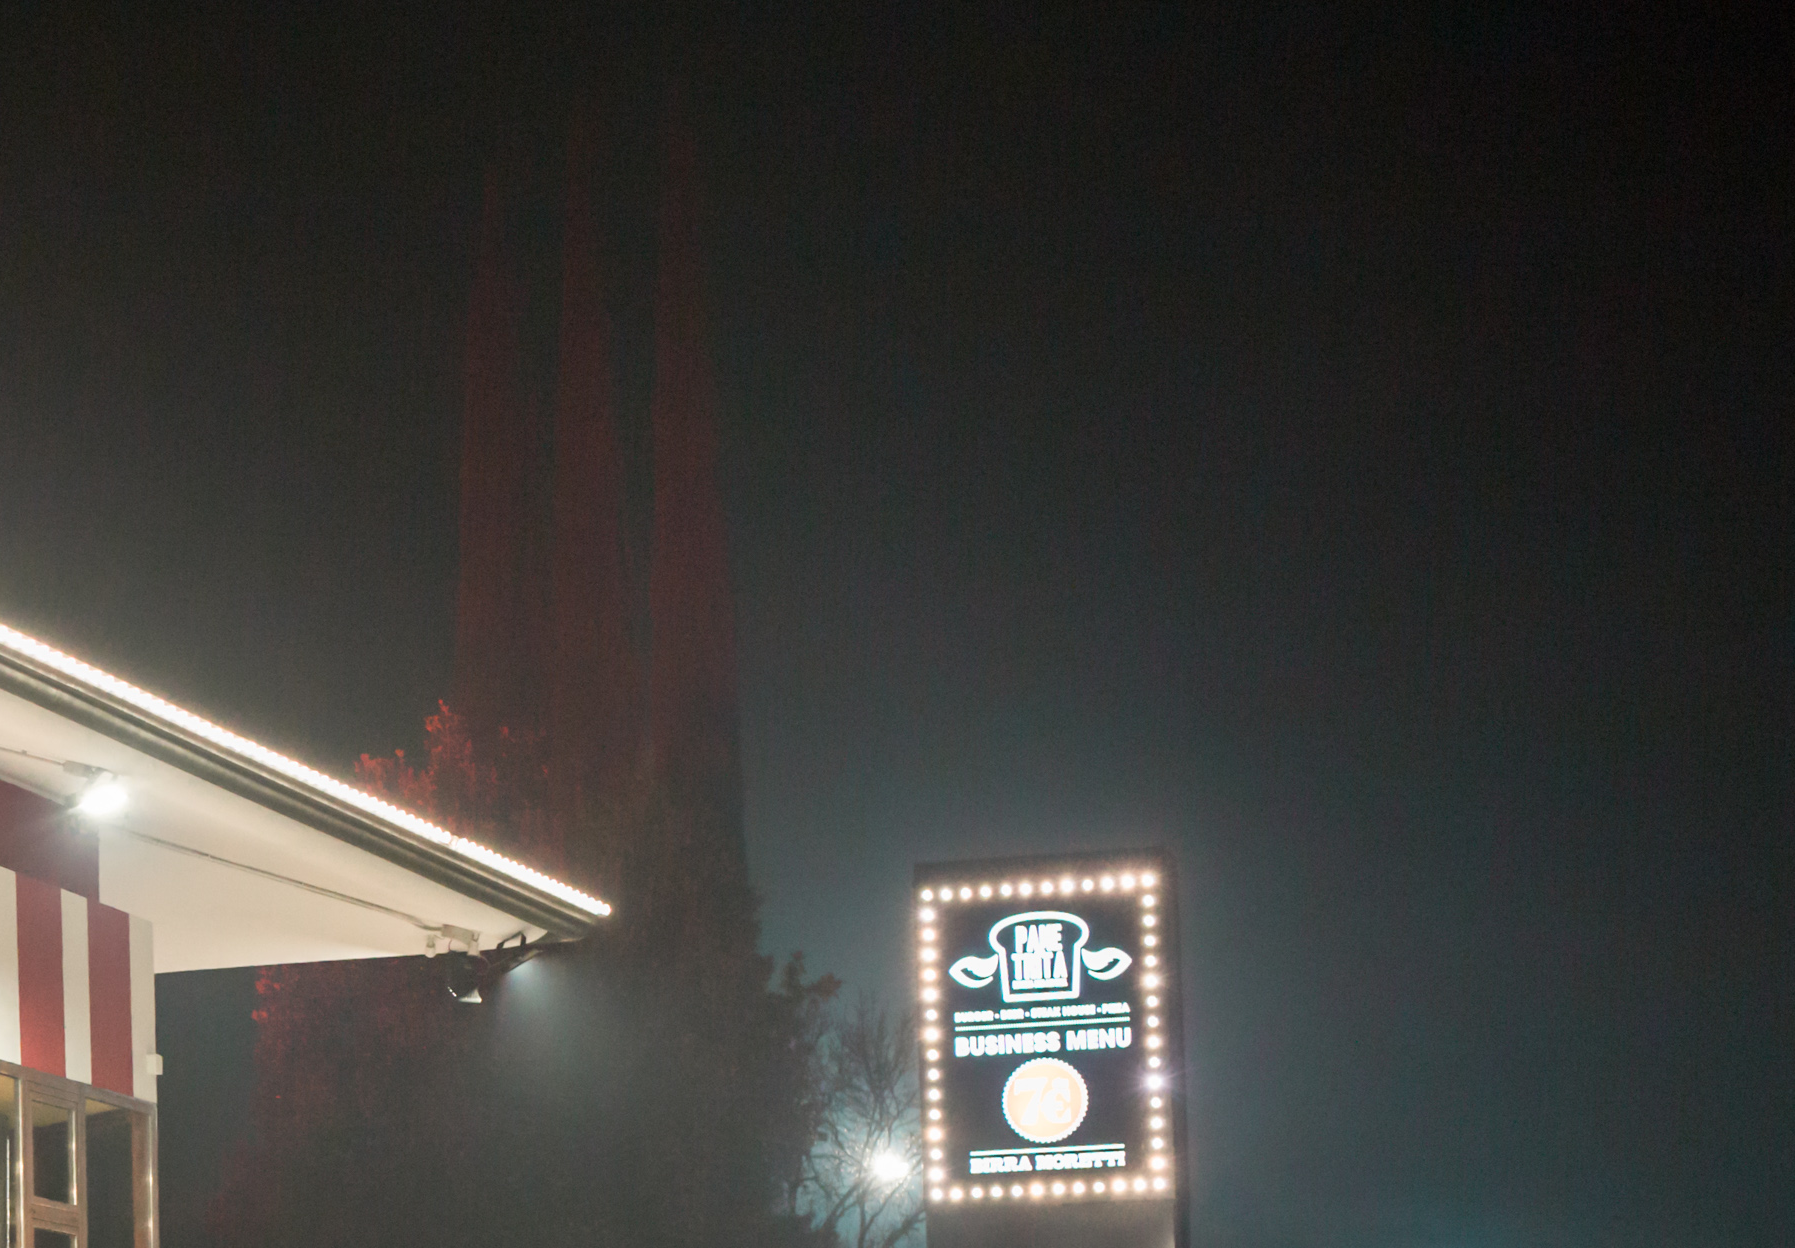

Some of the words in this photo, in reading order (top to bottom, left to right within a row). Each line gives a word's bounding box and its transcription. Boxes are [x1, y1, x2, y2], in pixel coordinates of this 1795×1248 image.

[1015, 923, 1063, 953] PANE
[954, 1031, 1061, 1057] BUSINESS
[1066, 1027, 1132, 1051] MENU
[969, 1155, 1033, 1174] BIRRA
[1035, 1150, 1126, 1171] MORETTI
